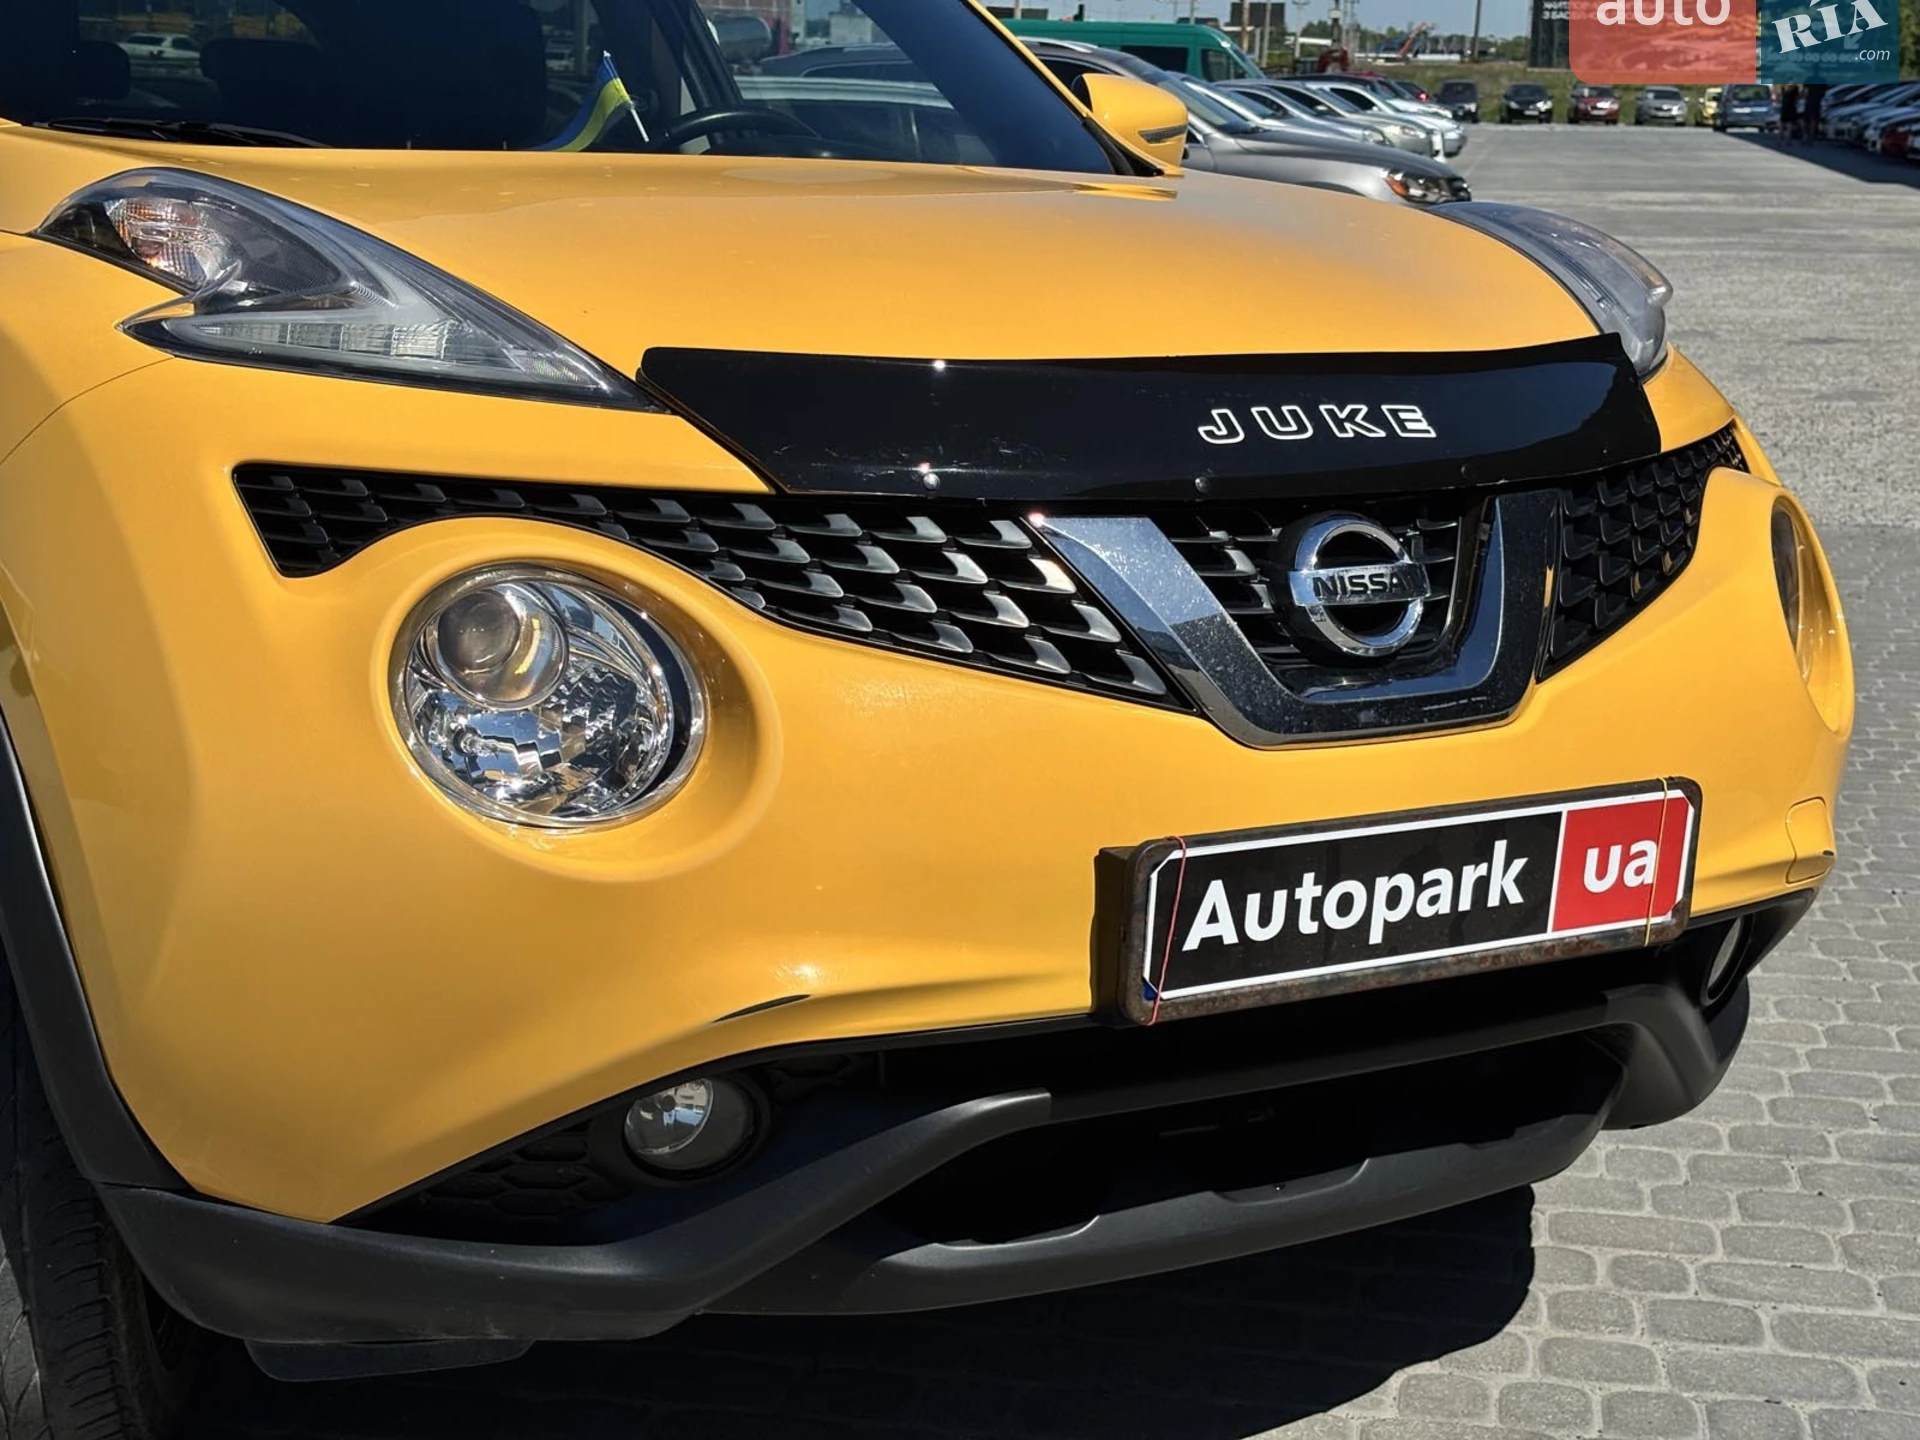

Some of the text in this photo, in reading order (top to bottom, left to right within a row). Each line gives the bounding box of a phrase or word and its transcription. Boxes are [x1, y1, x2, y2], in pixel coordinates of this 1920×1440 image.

[1198, 404, 1437, 445] JUKE
[1182, 839, 1658, 952] Autopark ua
